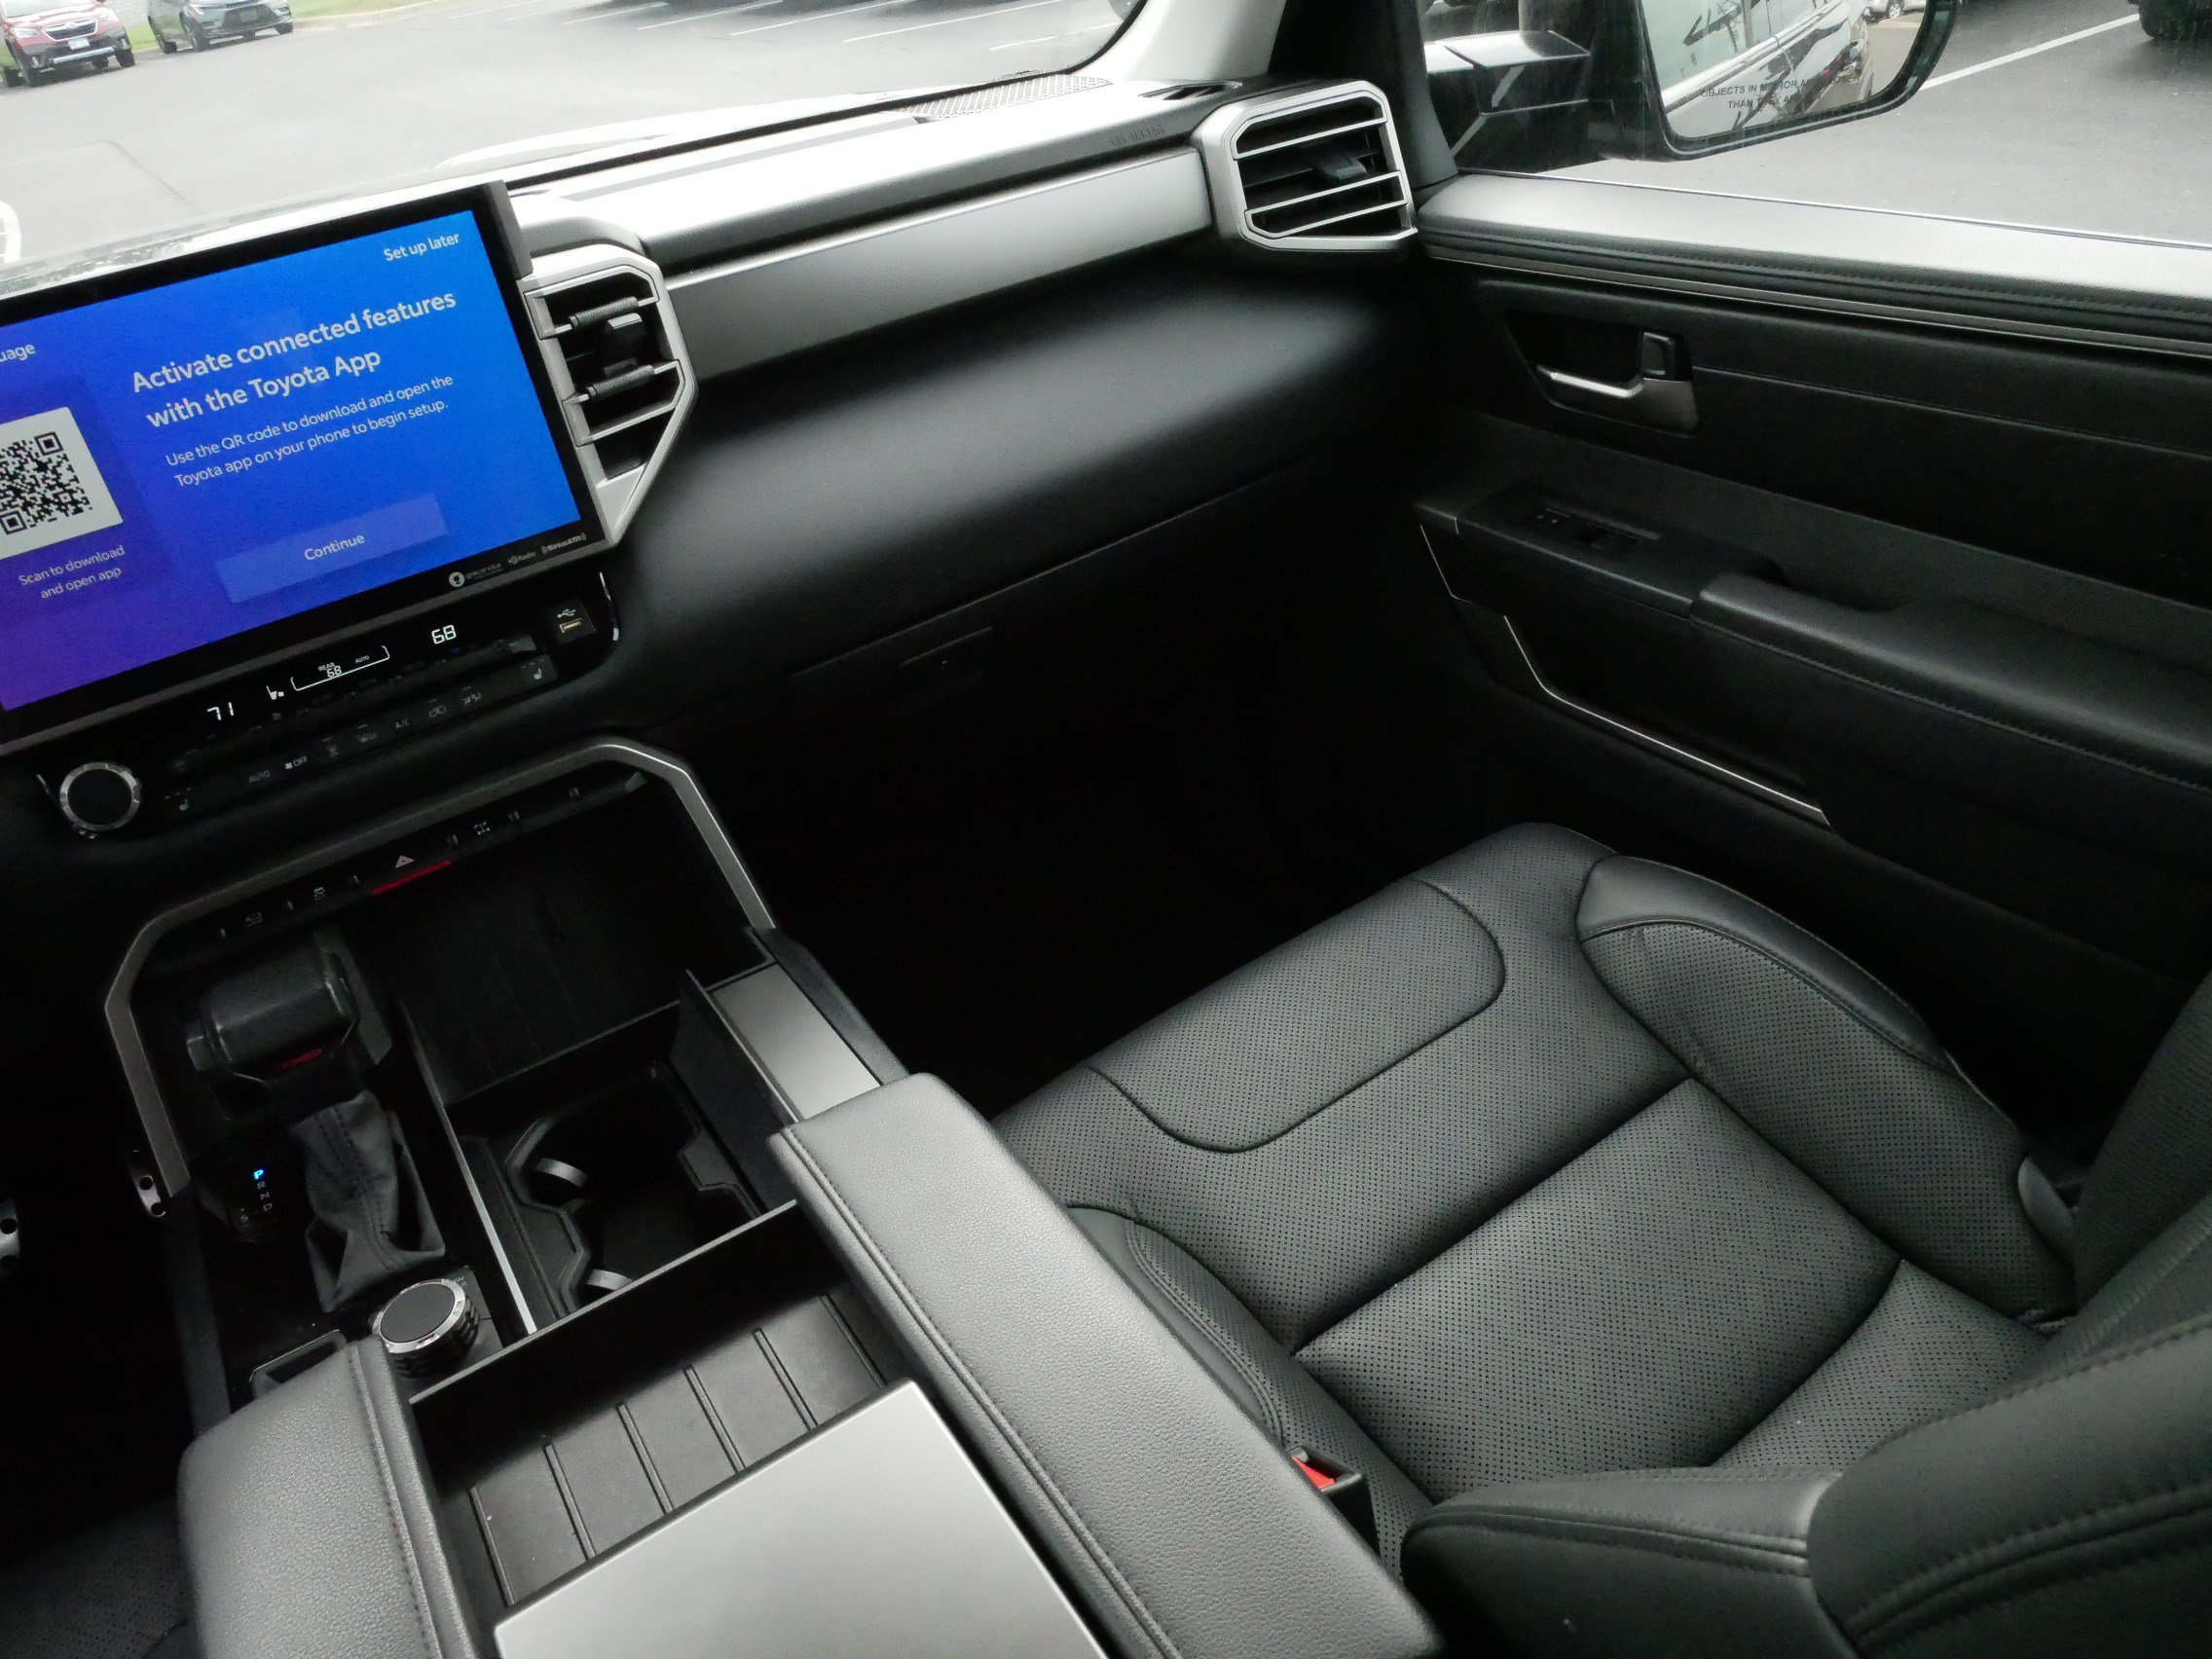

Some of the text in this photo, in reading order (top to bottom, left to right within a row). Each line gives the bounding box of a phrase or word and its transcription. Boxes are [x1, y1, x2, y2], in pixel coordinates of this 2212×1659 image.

[1701, 85, 1746, 97] OBJECTS
[1748, 84, 1757, 92] IN
[1728, 98, 1753, 109] THAN
[384, 234, 460, 261] Set up later
[133, 292, 457, 393] Activate connected features
[146, 351, 381, 427] with the Toyota App
[166, 376, 454, 466] Use the QR code to download and open the
[174, 400, 449, 487] Toyota app on your phone to begin setup.
[304, 535, 366, 561] Continue
[18, 545, 126, 586] Scan to download
[41, 568, 123, 599] and open app
[430, 624, 458, 645] 68
[326, 665, 343, 679] 68
[206, 701, 235, 721] 71
[395, 719, 410, 729] A/C
[293, 756, 309, 767] OFF
[248, 769, 271, 784] AUTO
[253, 1168, 264, 1180] P
[263, 1202, 274, 1212] D
